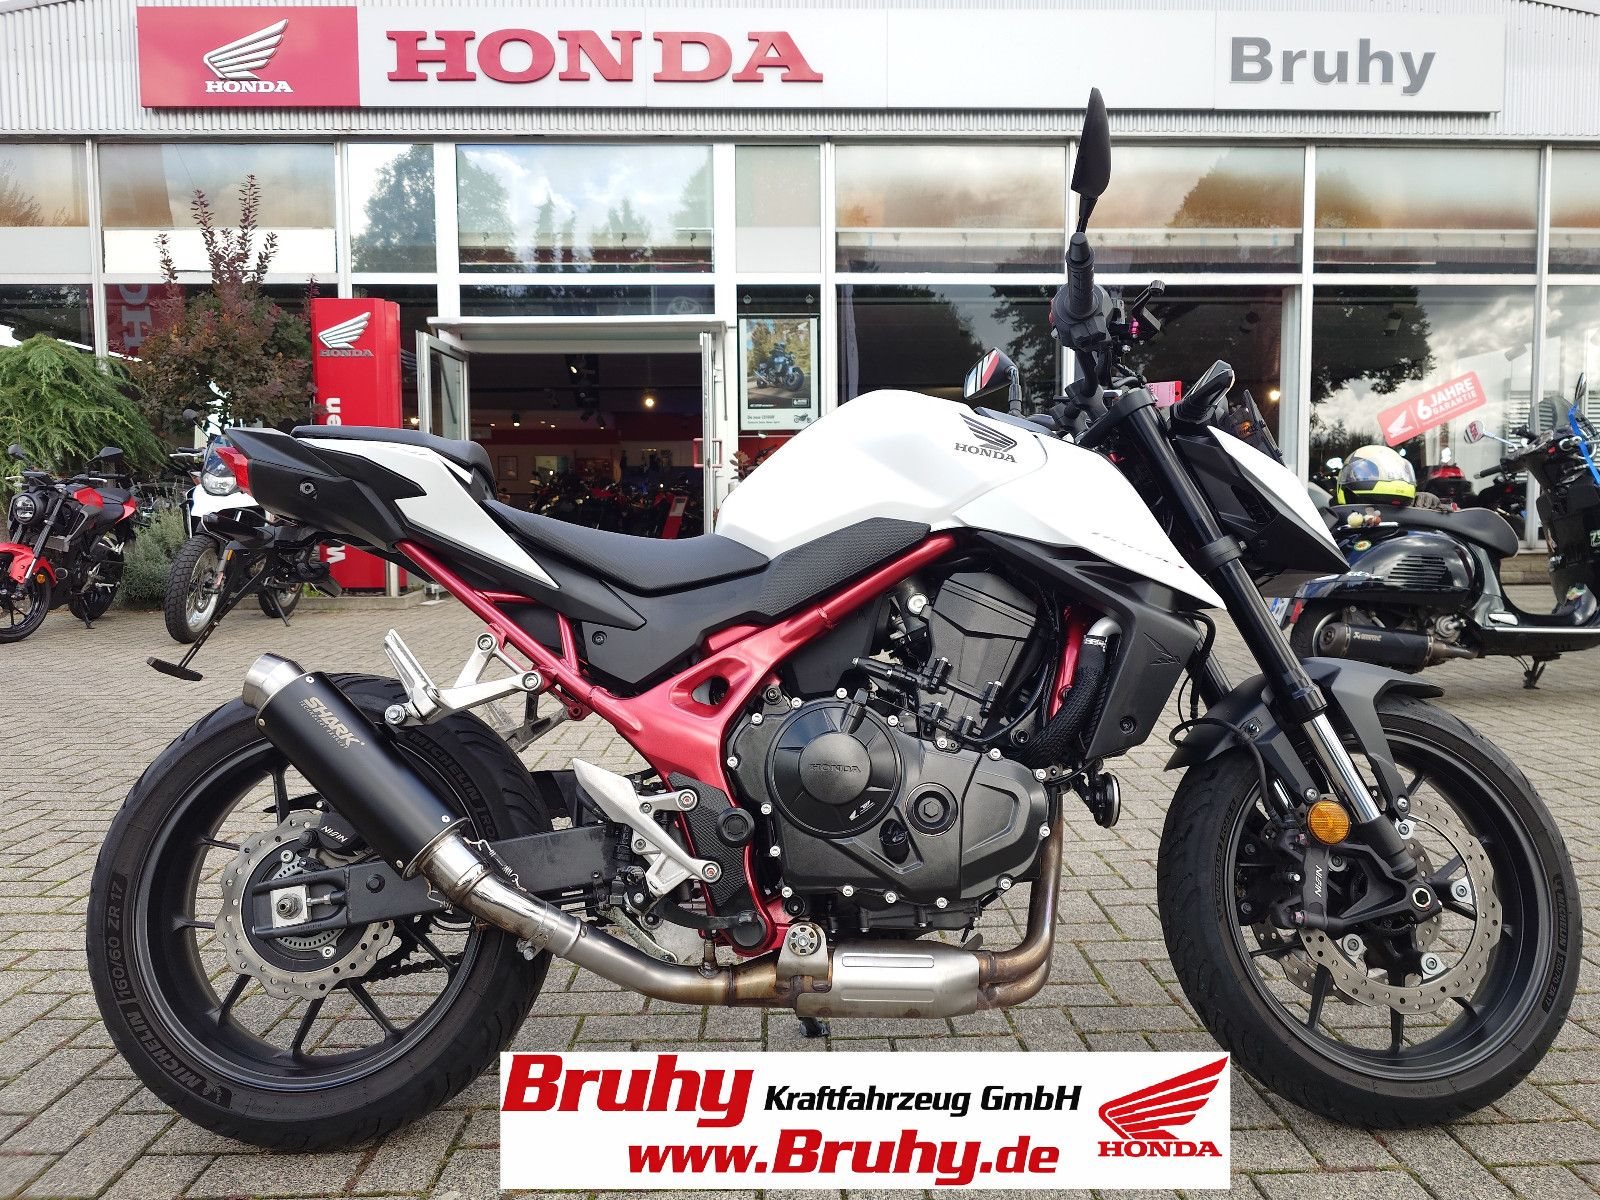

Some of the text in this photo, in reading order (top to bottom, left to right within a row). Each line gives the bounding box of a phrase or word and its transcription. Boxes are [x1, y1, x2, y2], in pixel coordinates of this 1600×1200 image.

[386, 28, 824, 84] HONDA
[1230, 36, 1436, 96] Bruhy
[205, 80, 294, 94] HONDA
[319, 348, 375, 358] HONDA
[1416, 379, 1475, 420] 6 JAHRE
[1432, 389, 1478, 415] GARANTIE
[954, 442, 1018, 464] HONDA
[302, 696, 361, 748] SHARK
[808, 763, 862, 773] HONDA
[110, 880, 123, 902] 17
[107, 907, 121, 931] ZR
[126, 1009, 203, 1090] MICHELIN
